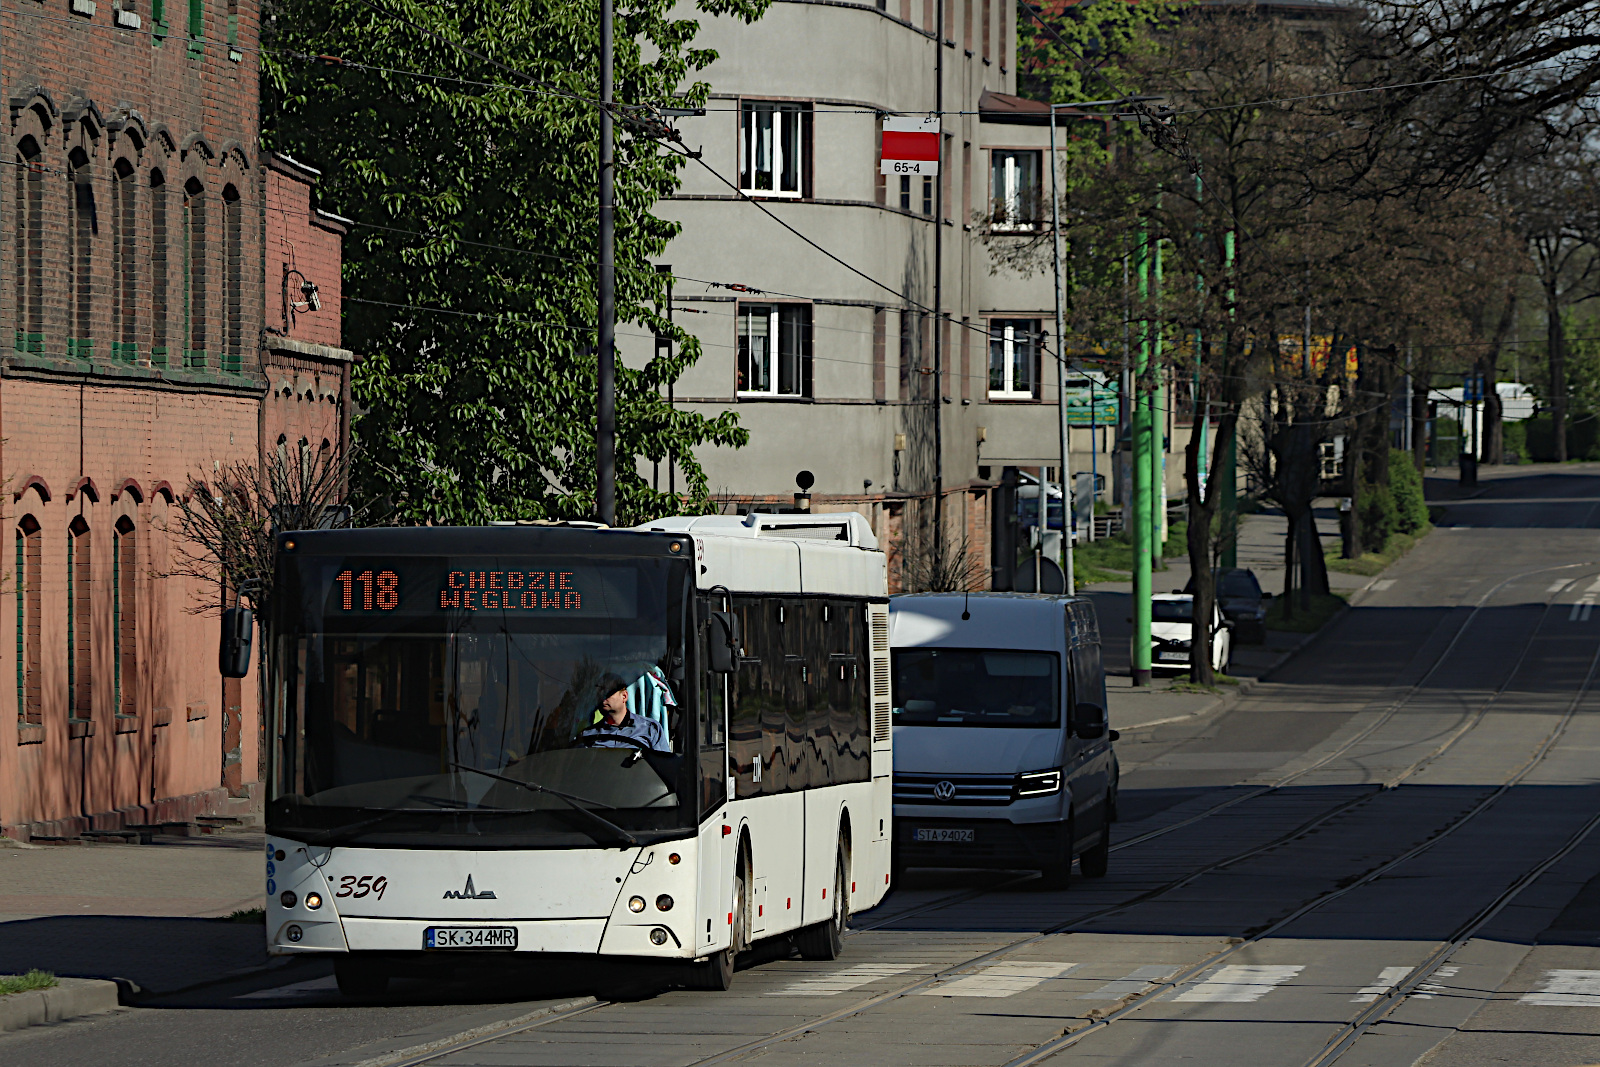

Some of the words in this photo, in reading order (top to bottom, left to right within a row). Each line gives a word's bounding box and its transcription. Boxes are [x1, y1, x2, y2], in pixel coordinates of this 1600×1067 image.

[894, 162, 920, 174] 65-4
[448, 571, 573, 589] CHEBZIE
[336, 571, 398, 610] 118
[441, 590, 581, 610] WĘGLOWA
[918, 829, 938, 841] STA
[941, 829, 974, 841] 94024
[335, 875, 388, 901] 359
[437, 930, 459, 946] SK
[465, 929, 513, 945] 344MR
